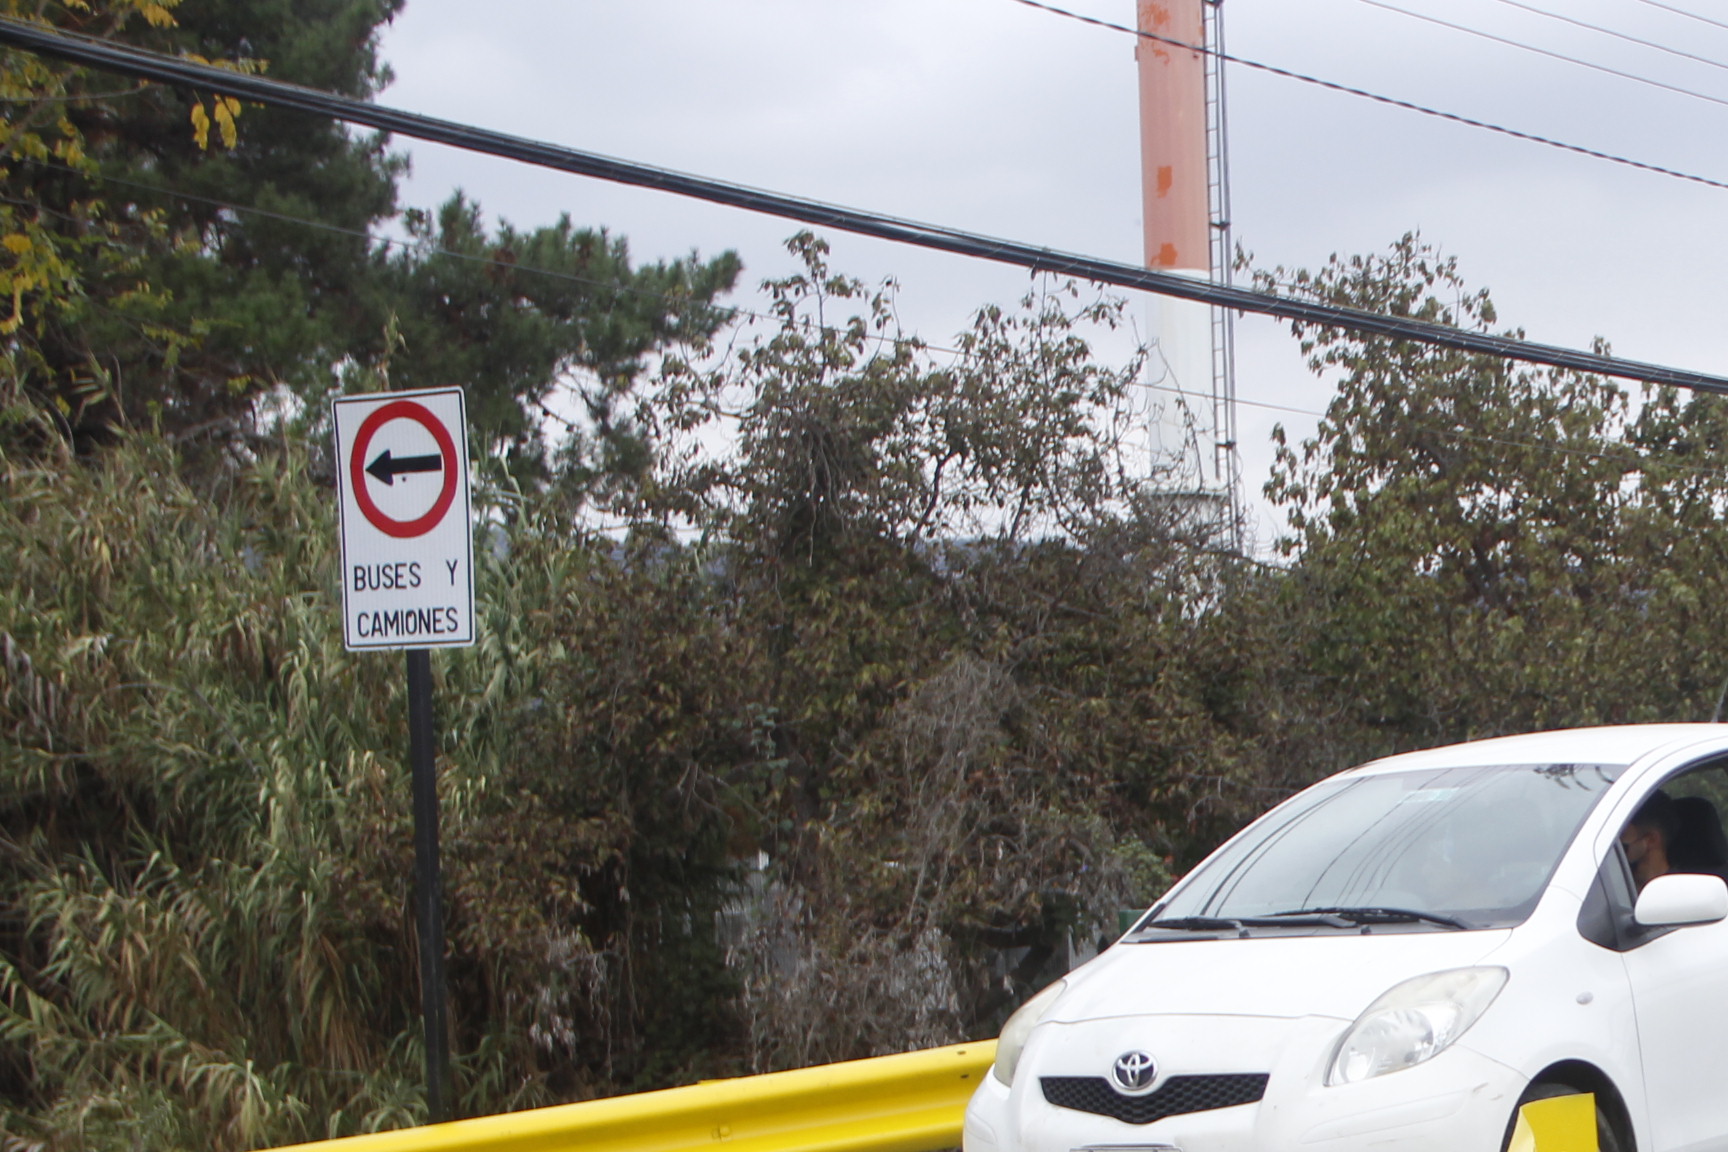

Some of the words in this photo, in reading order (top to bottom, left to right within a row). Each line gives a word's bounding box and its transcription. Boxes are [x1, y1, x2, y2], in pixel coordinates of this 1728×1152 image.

[354, 562, 421, 592] BUSES
[446, 559, 458, 586] Y
[357, 607, 459, 638] CAMIONES
